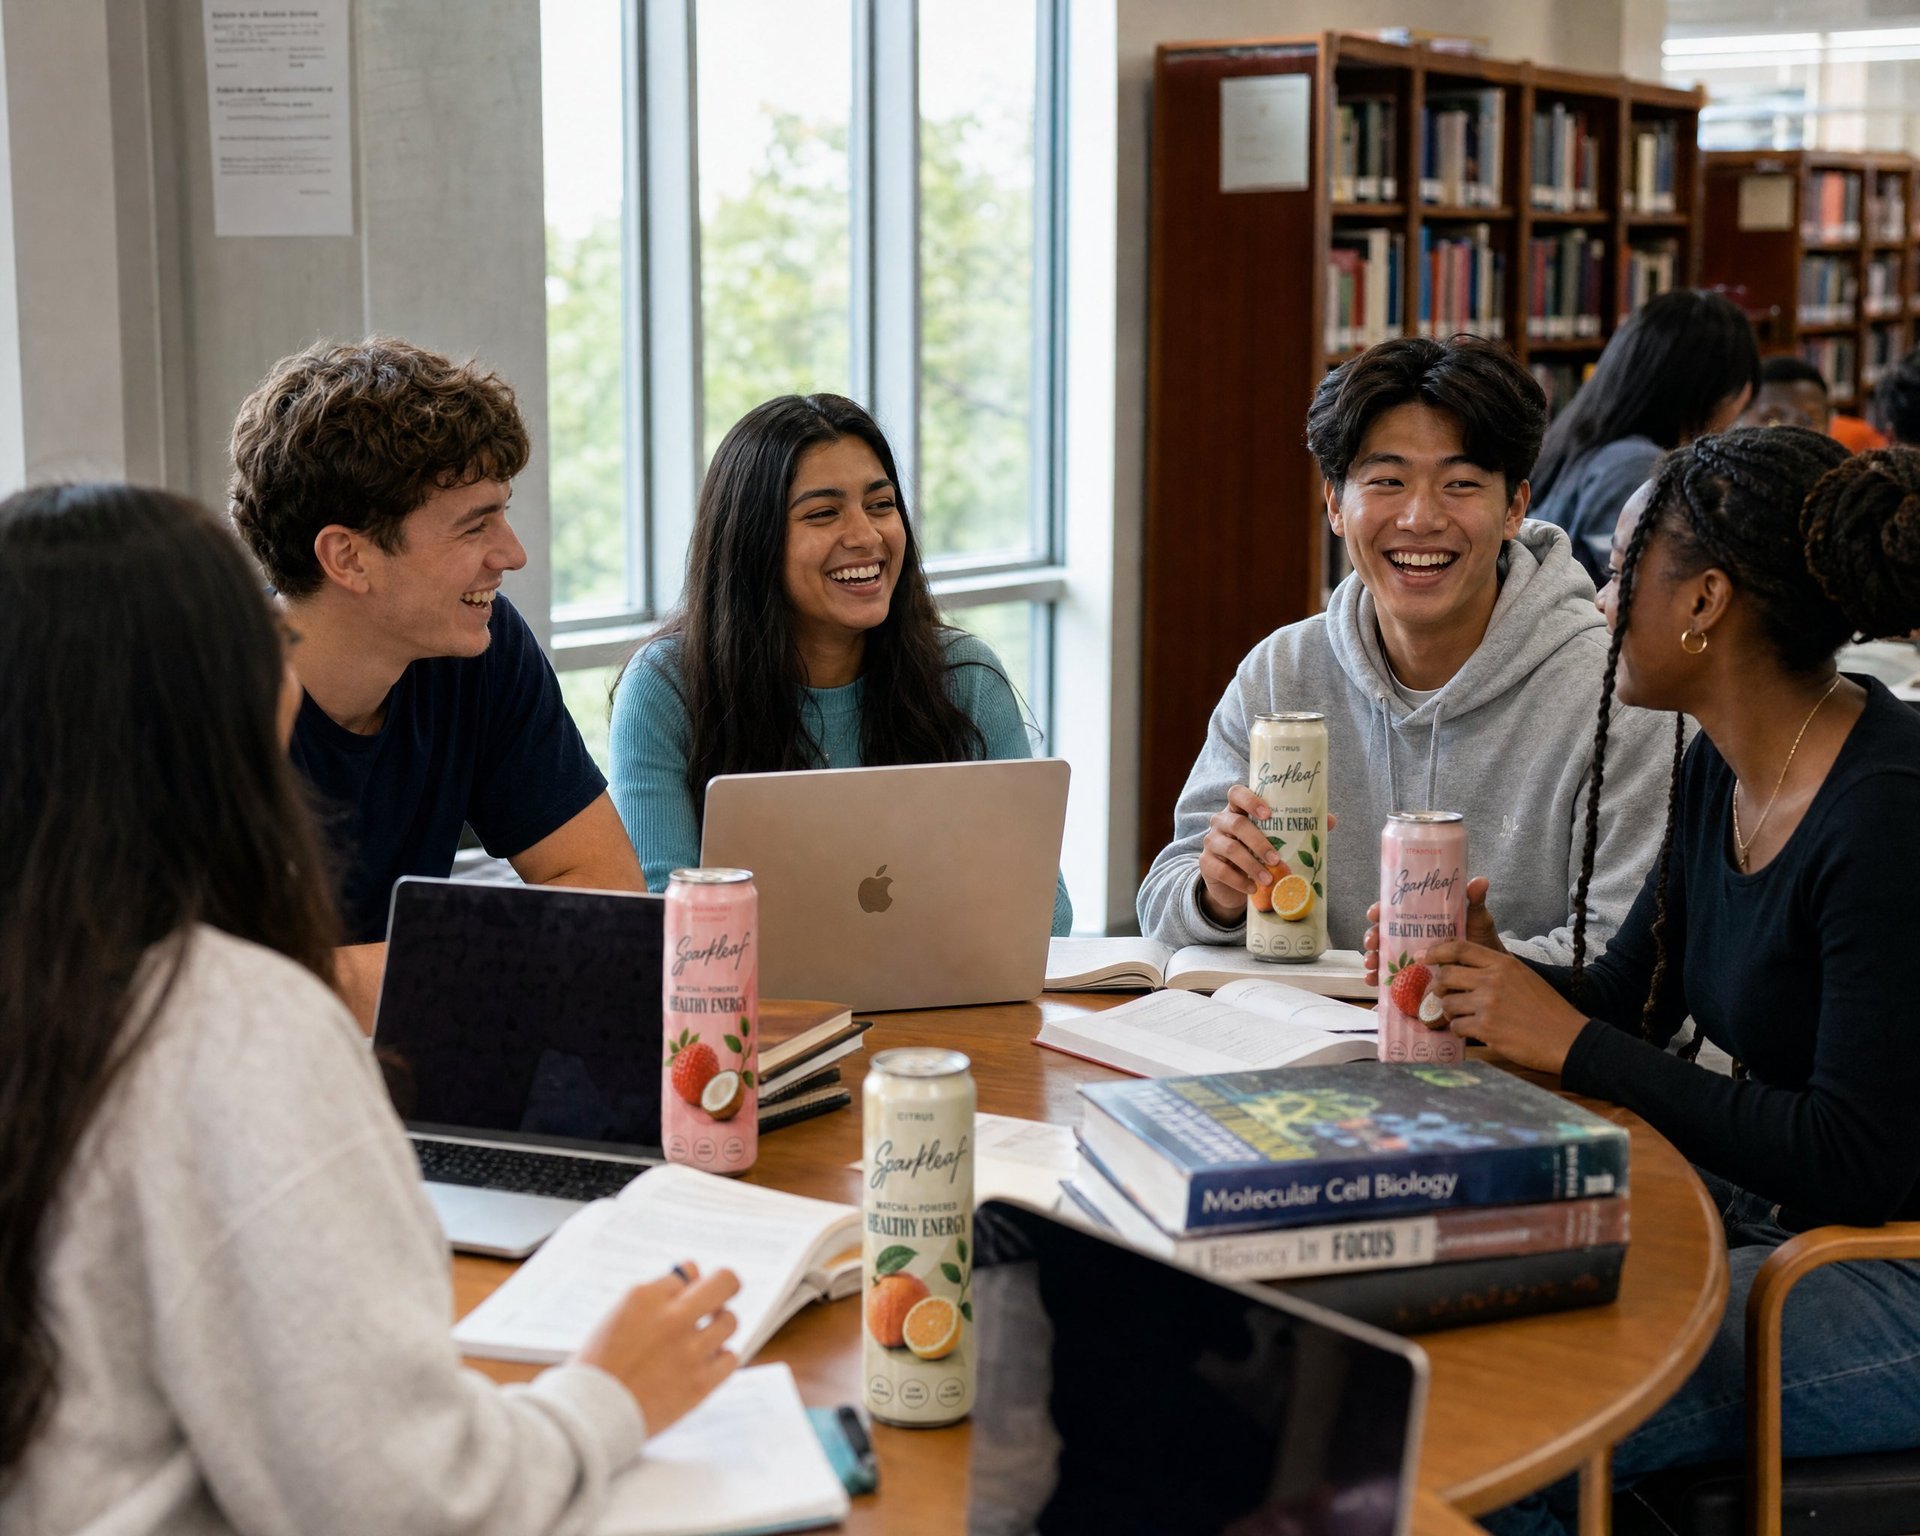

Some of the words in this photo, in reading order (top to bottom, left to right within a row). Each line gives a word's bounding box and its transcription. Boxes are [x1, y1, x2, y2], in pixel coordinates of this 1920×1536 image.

[1254, 760, 1321, 798] Sparkleaf
[1285, 806, 1312, 814] POWERED
[1287, 816, 1319, 832] ENERGY
[1390, 867, 1459, 906] Sparkleaf
[1388, 921, 1424, 938] HEALTHY
[1426, 922, 1457, 938] ENERGY
[671, 931, 751, 977] Sparkleaf
[675, 985, 701, 993] MATCHA
[708, 985, 739, 993] POWERED
[670, 995, 708, 1013] HEALTHY
[711, 996, 747, 1013] ENERGY
[896, 1112, 935, 1121] CITRUS
[869, 1134, 968, 1190] Sparkleaf
[1202, 1180, 1322, 1214] Molecular
[1325, 1175, 1369, 1203] Cell
[1374, 1170, 1459, 1200] Biology
[875, 1200, 909, 1213] MATCHA
[918, 1201, 957, 1213] POWERED
[868, 1212, 916, 1238] HEALTHY
[922, 1213, 967, 1238] ENERGY
[1332, 1227, 1396, 1261] FOCUS
